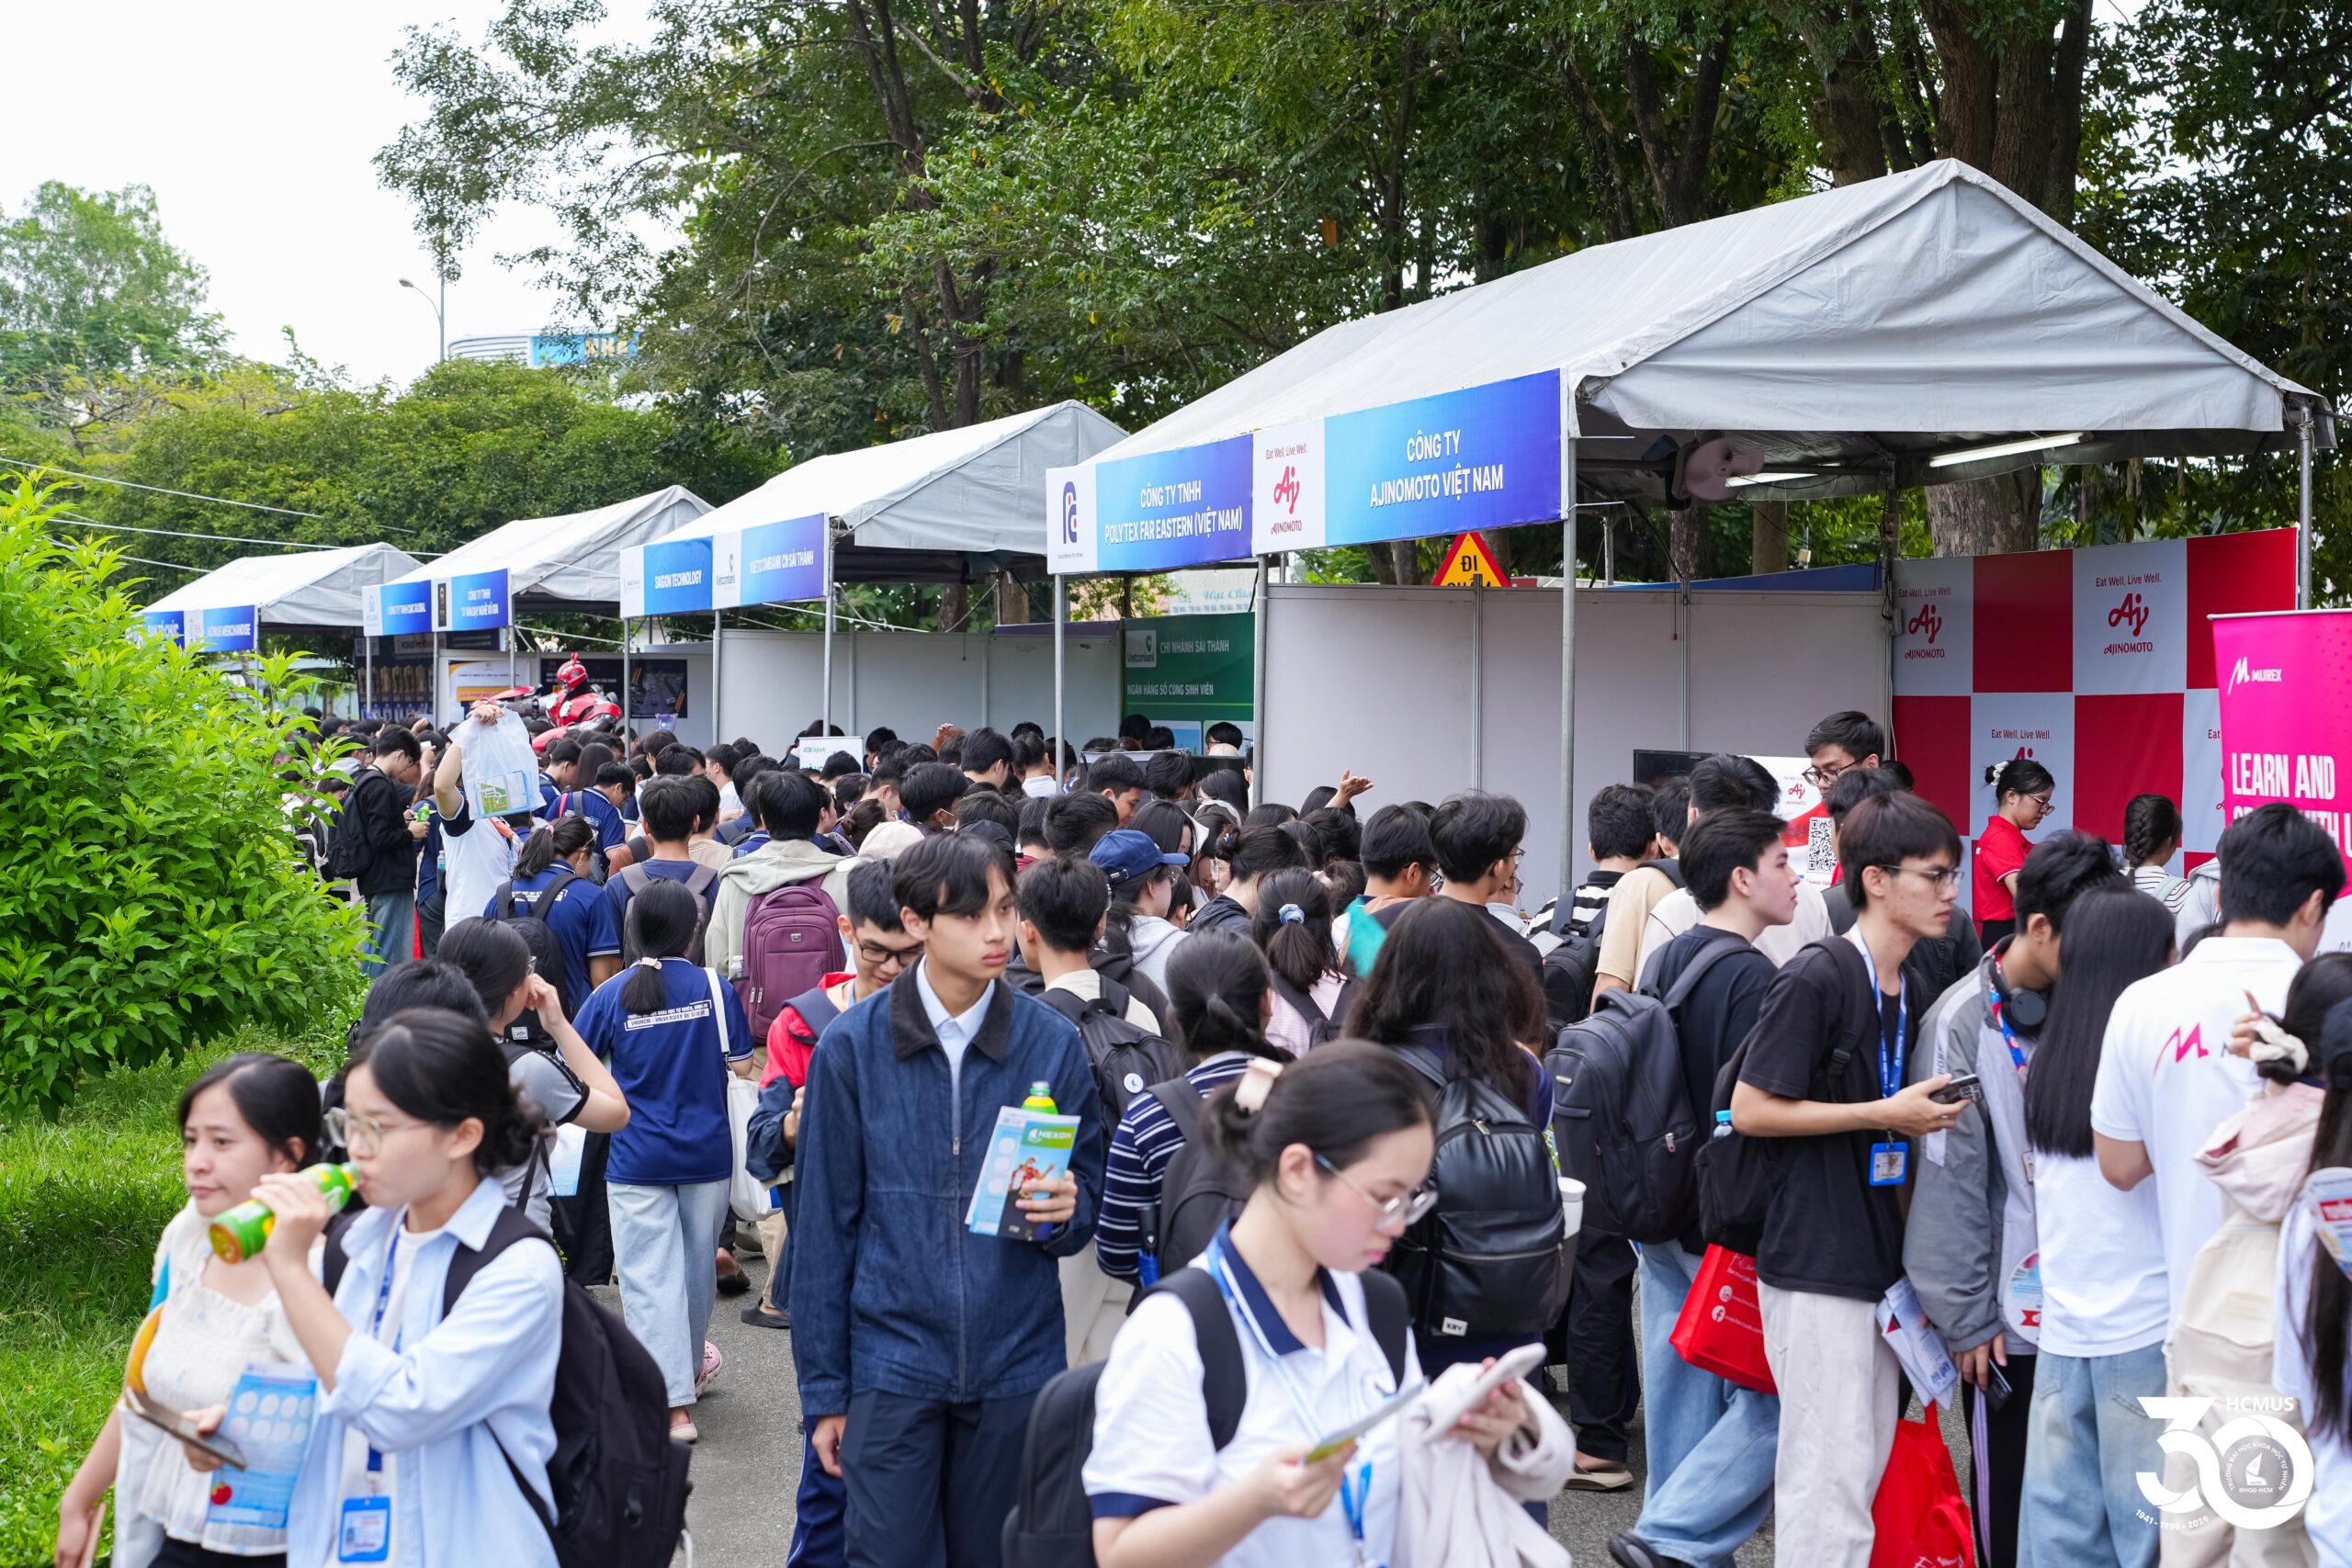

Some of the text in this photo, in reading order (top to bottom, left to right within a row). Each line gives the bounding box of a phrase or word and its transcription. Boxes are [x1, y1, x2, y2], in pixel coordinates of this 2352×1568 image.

[1286, 445, 1295, 456] Live
[1407, 429, 1462, 463] CÔNG TY
[1371, 463, 1504, 508] AJINOMOTO VIỆT NAM
[1140, 479, 1202, 509] CÔNG TY TNHH
[1105, 505, 1243, 545] POLYTEX FAR EASTERN (VIỆT NAM)
[1271, 520, 1302, 535] AJINOMOTO
[750, 555, 782, 574] VIETCOMBANK
[1461, 555, 1477, 572] ĐI
[655, 570, 702, 589] SAIGON TECHNOLOGY
[2096, 573, 2162, 587] Eat Well, Live Well.
[1898, 589, 1908, 598] Eat
[1925, 588, 1937, 597] Live
[1160, 642, 1171, 653] CHI
[1171, 639, 1194, 653] NHÁNH
[1206, 638, 1229, 652] THÀNH
[2104, 641, 2154, 655] AJINOMOTO
[1127, 653, 1155, 662] Vietcombank
[1905, 649, 1945, 660] AJINOMOTO
[2251, 669, 2282, 682] MUREX
[1185, 684, 1199, 695] SINH
[1199, 682, 1214, 695] VIÊN
[1991, 729, 2002, 739] Eat
[2020, 729, 2034, 739] Live
[2208, 728, 2221, 739] Eat
[2232, 752, 2336, 800] LEARN AND
[1038, 1130, 1072, 1140] NEXON
